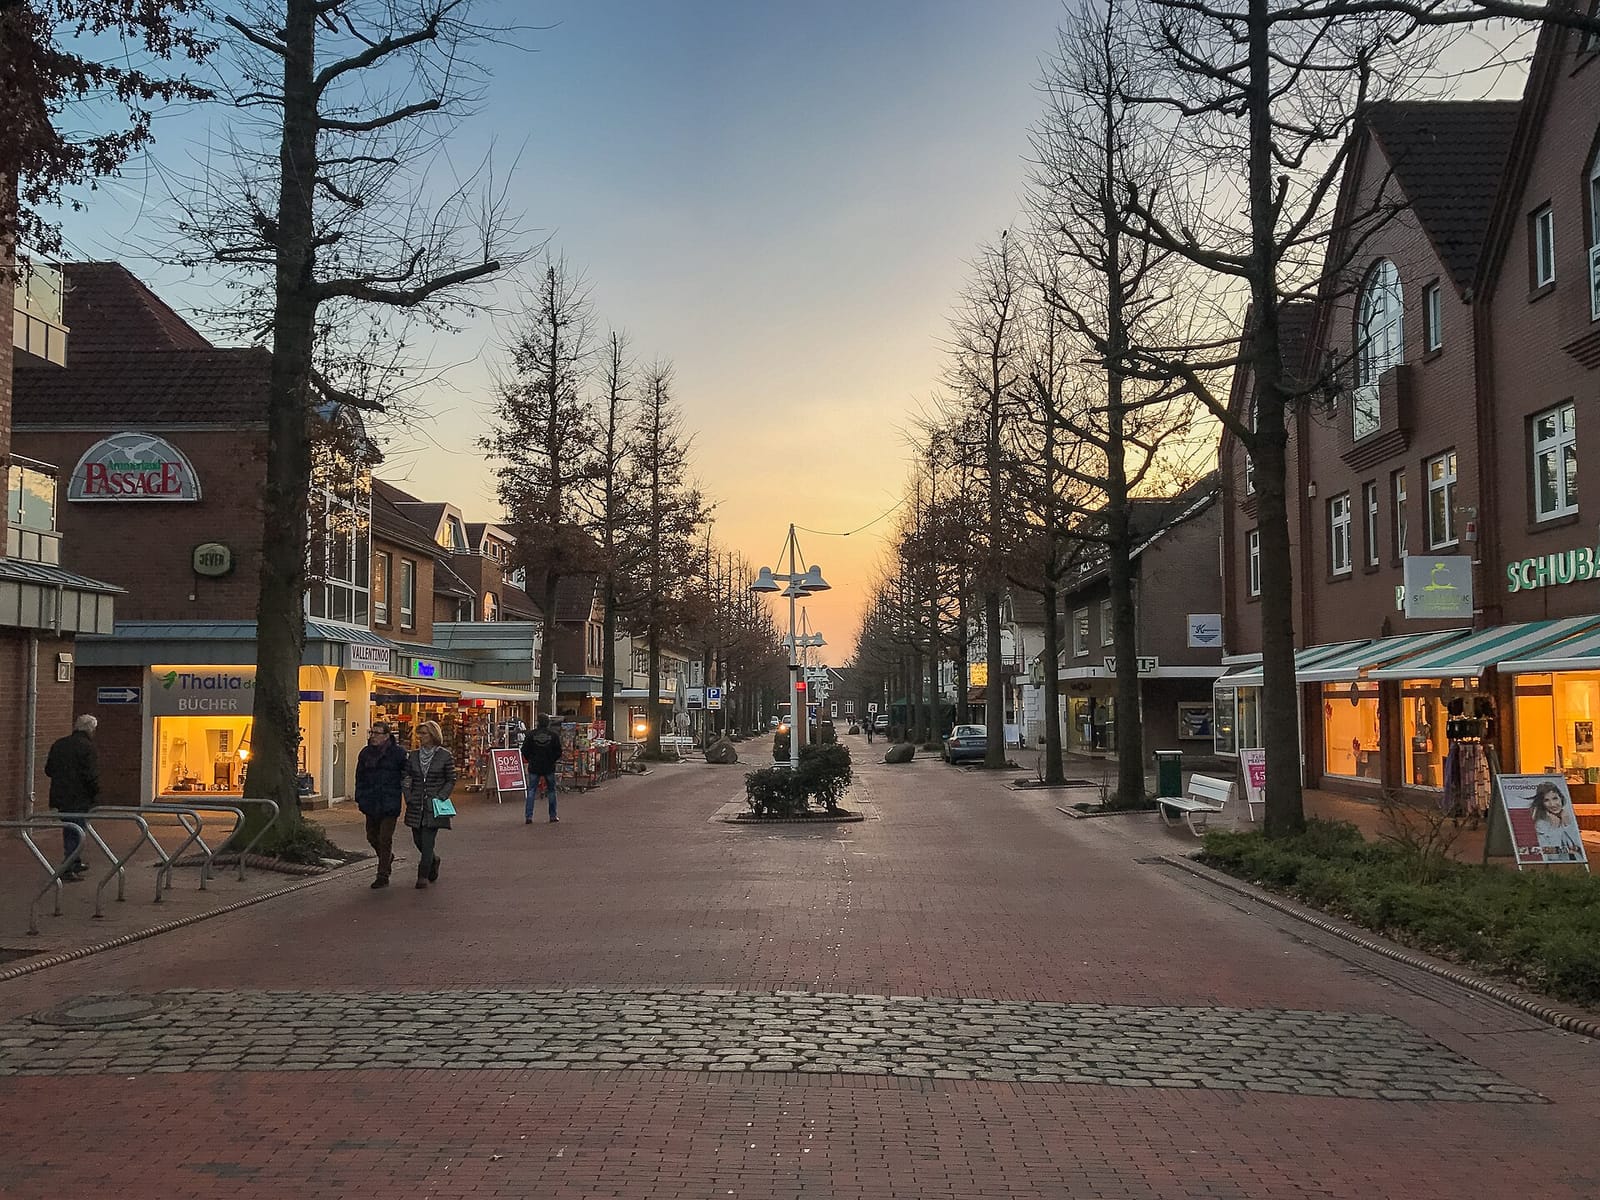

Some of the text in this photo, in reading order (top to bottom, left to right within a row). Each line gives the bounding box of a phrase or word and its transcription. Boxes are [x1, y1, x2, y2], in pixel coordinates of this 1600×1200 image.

[83, 463, 182, 494] PASSAGE
[199, 552, 225, 567] JEVER
[1105, 659, 1155, 672] WLF
[178, 696, 237, 710] BÜCHER
[497, 755, 519, 766] 50%
